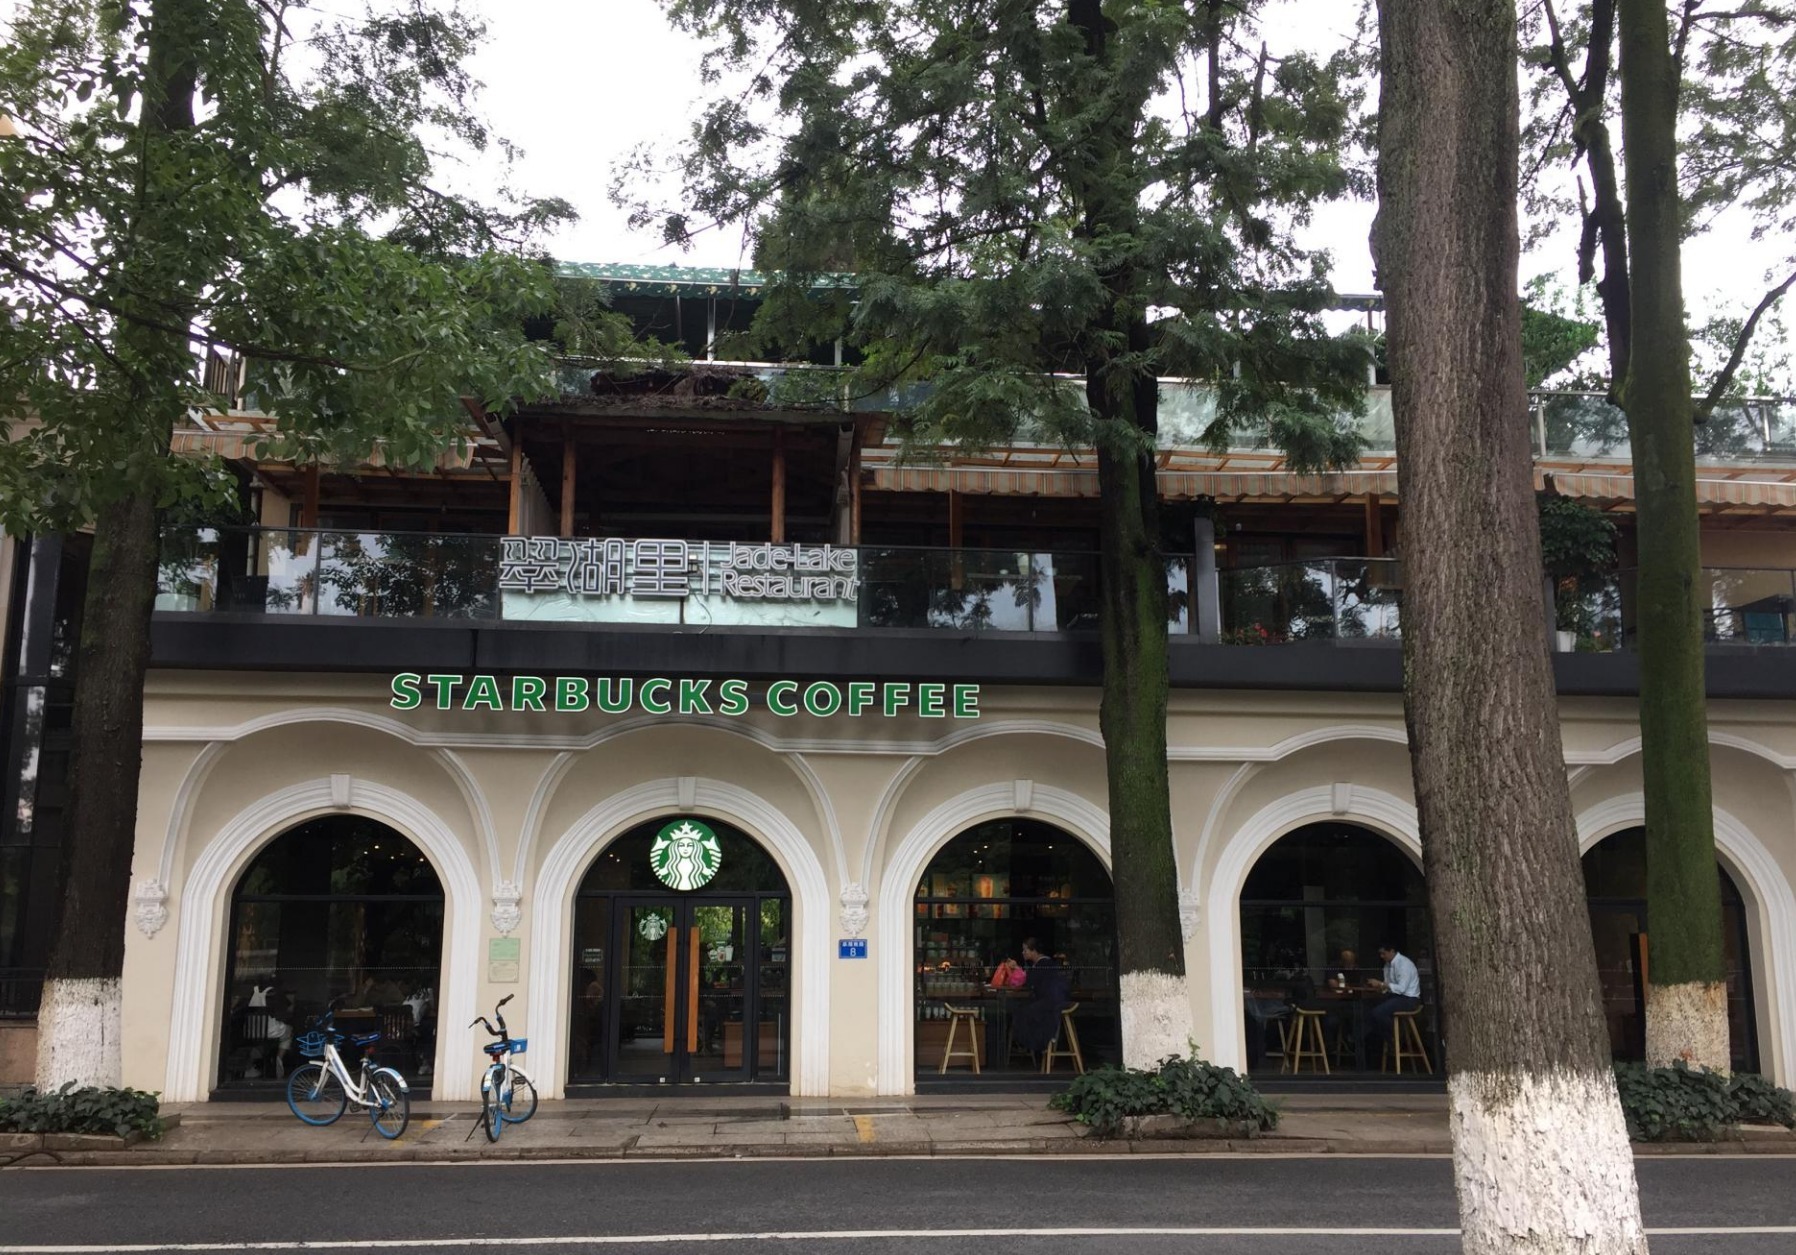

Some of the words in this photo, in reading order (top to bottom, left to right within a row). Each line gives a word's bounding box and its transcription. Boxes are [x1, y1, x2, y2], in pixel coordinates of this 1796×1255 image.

[499, 537, 689, 595] 翠湖里
[720, 541, 856, 571] Jade-Lake
[720, 569, 861, 600] Restaurant
[389, 672, 749, 716] STARBUCKS
[766, 680, 980, 718] COFFEE
